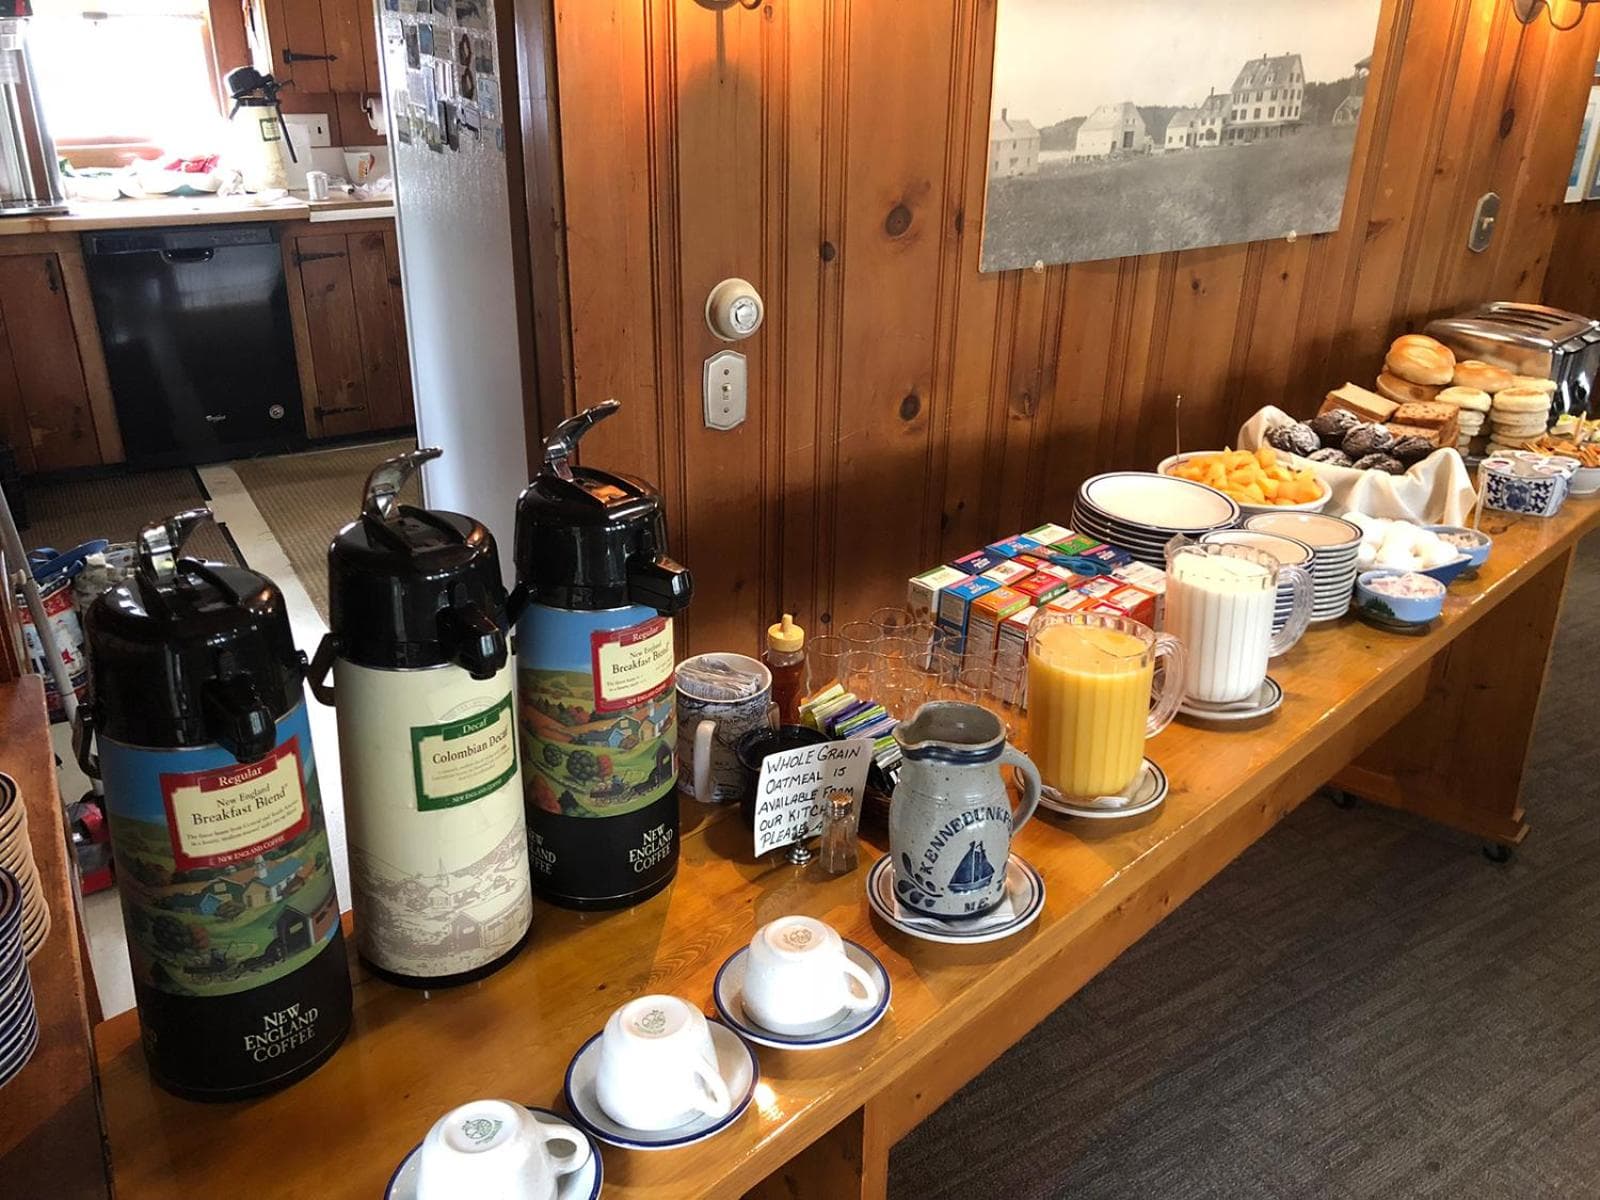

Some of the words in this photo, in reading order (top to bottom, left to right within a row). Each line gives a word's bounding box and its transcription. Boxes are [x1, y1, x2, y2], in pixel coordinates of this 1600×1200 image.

[612, 657, 651, 674] Breakfast
[462, 718, 488, 734] Decaf
[432, 742, 488, 765] Colombian
[767, 750, 815, 774] WHOLE
[817, 745, 861, 761] GRAIN
[218, 766, 263, 786] Regular
[766, 771, 823, 794] OATMEAL
[192, 803, 252, 826] Breakfast
[255, 786, 286, 809] Blend
[216, 798, 237, 808] New
[239, 783, 271, 801] England
[758, 789, 818, 815] AVAILABLE
[643, 823, 665, 845] NEW
[760, 814, 783, 832] OUR
[629, 828, 673, 863] ENGLAND
[634, 843, 671, 873] COFFEE
[217, 854, 234, 863] NEW
[263, 1003, 300, 1030] NEW
[244, 1008, 318, 1051] ENGLAND
[253, 1024, 316, 1063] COFFEE
